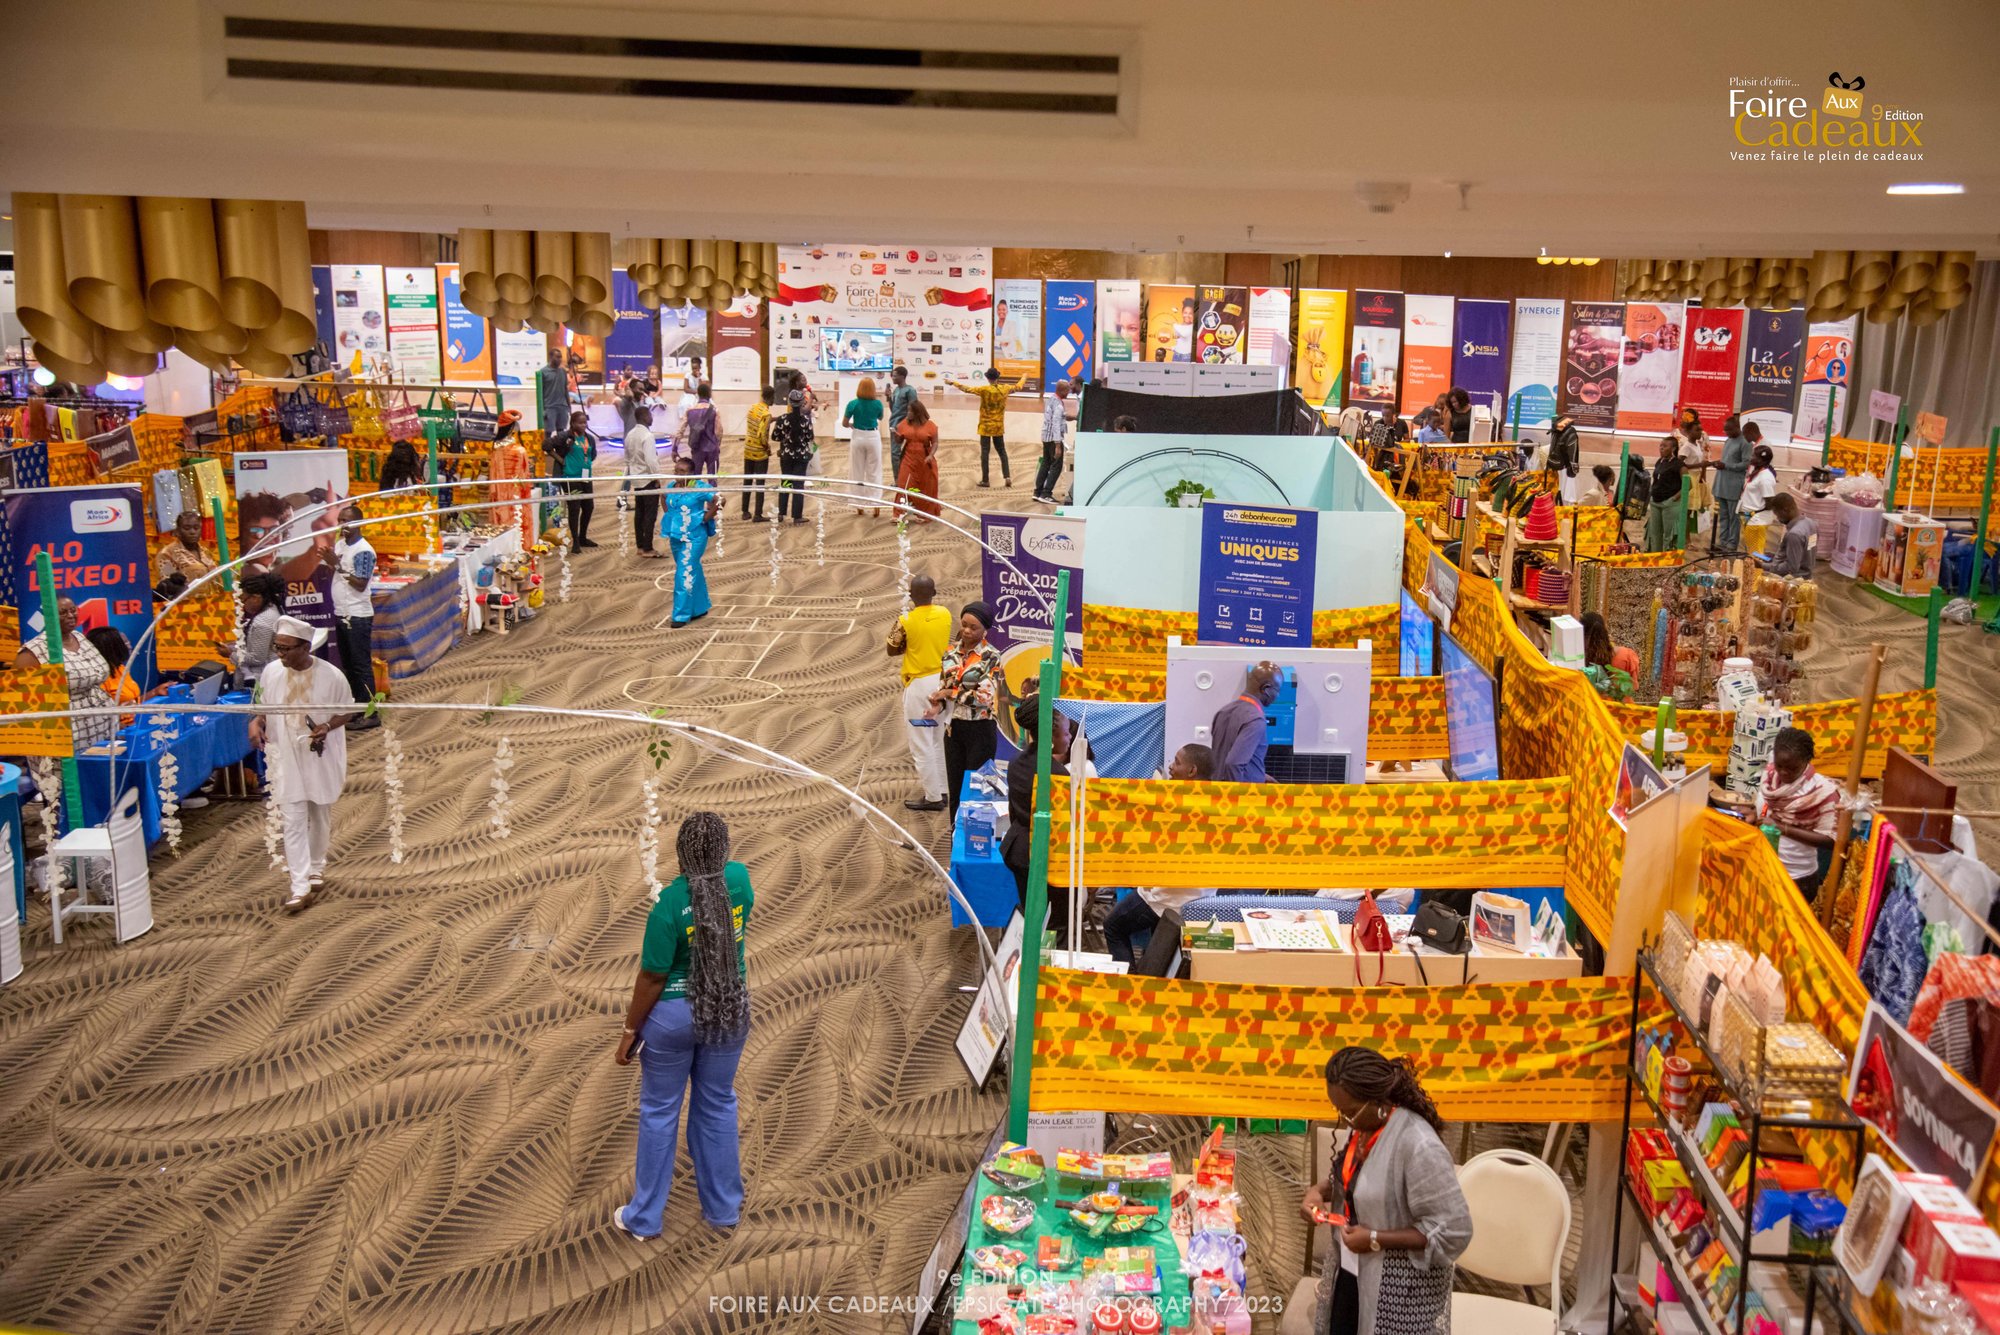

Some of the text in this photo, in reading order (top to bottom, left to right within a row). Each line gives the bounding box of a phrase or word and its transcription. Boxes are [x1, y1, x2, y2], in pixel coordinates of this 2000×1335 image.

[846, 285, 875, 296] Foire
[848, 293, 916, 308] Cadeaux
[1518, 306, 1561, 316] SYNERGIE
[1573, 305, 1594, 320] Salon
[1751, 347, 1774, 364] La
[1750, 363, 1793, 378] cave
[1758, 376, 1791, 385] Bourgeois
[1225, 511, 1238, 519] 24h
[25, 540, 83, 566] ALO
[1219, 541, 1300, 562] UNIQUES
[28, 562, 137, 592] LEKEO !
[999, 571, 1059, 589] CAN 202
[287, 582, 316, 596] SIA
[113, 599, 143, 615] ER
[291, 594, 317, 605] Auto
[994, 594, 1073, 625] Décollr
[1076, 1117, 1096, 1125] TOGO
[1903, 1086, 1977, 1178] SOYNIKA
